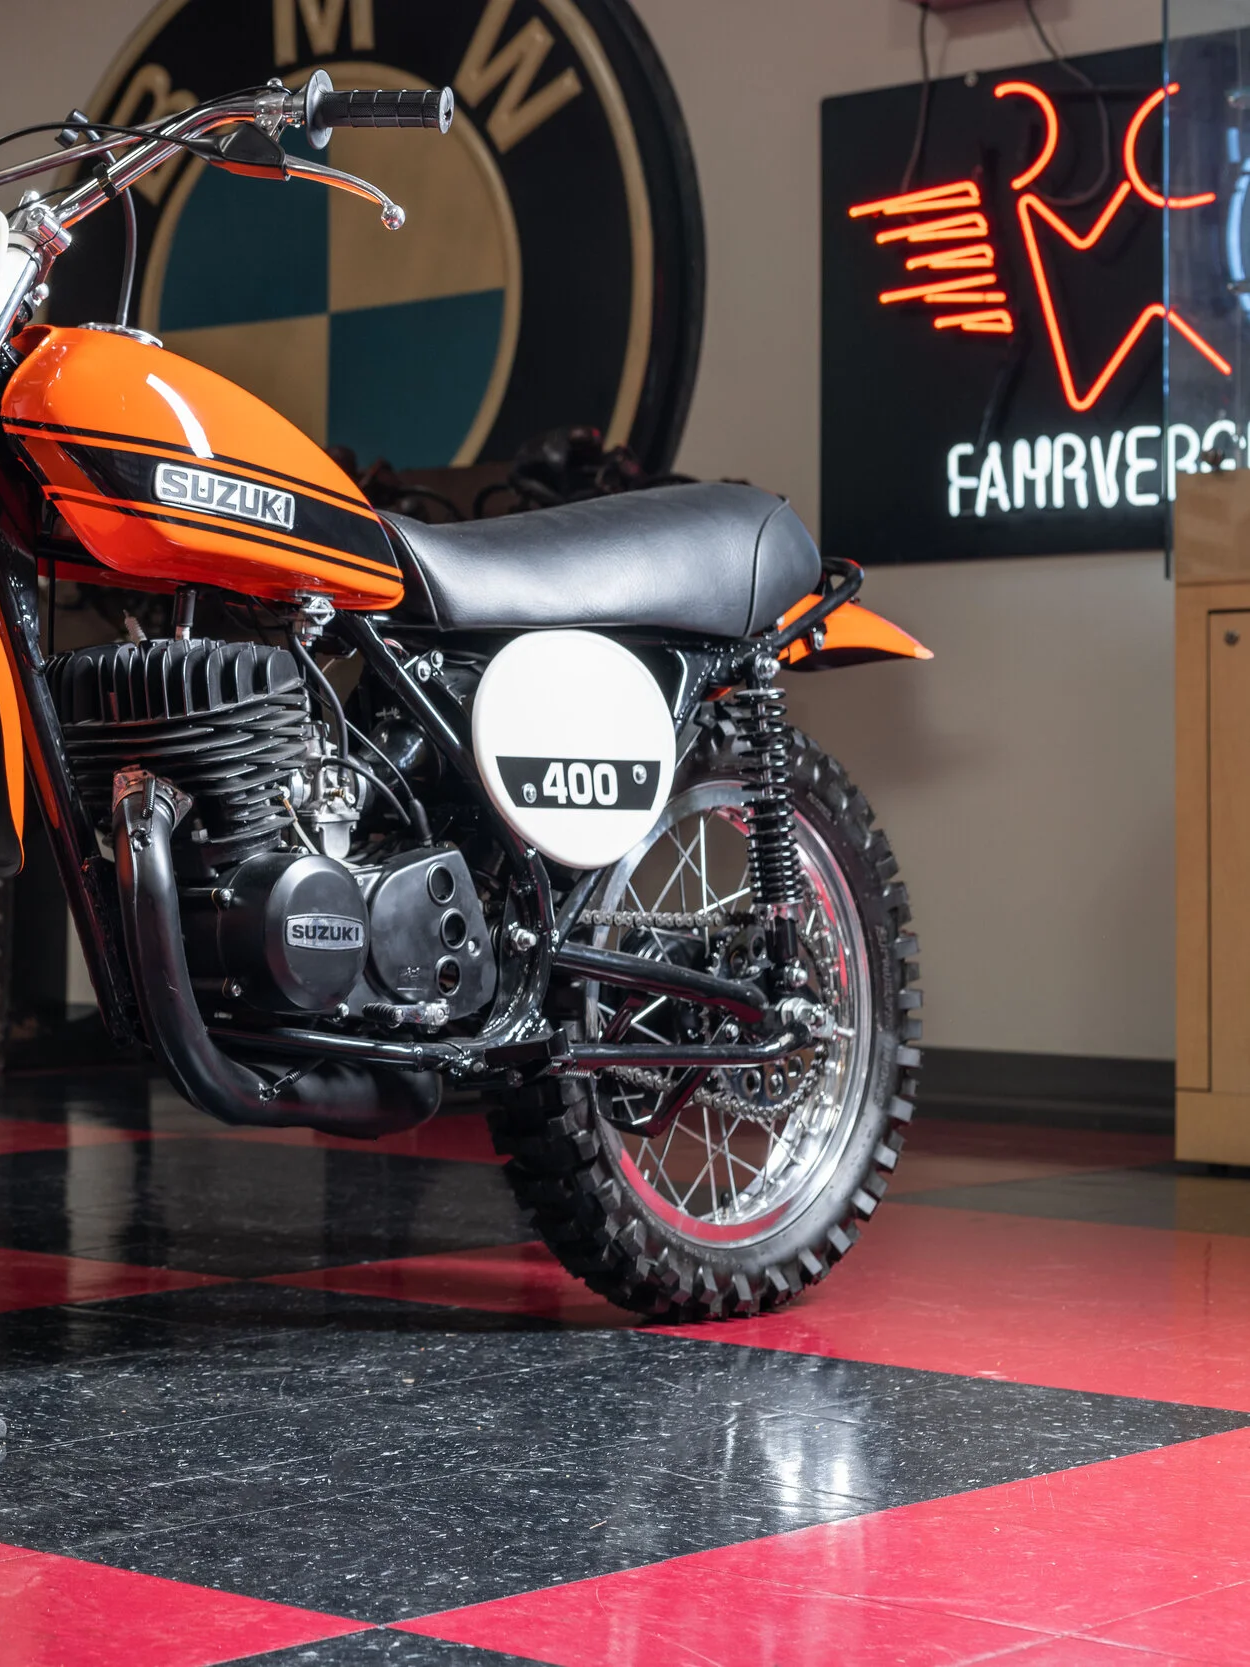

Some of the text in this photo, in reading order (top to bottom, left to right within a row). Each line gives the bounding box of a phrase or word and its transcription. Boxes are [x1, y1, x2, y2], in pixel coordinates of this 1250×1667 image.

[948, 419, 1250, 517] FAHRVERG
[161, 468, 293, 526] SUZUKI
[542, 761, 618, 806] 400
[291, 923, 360, 942] SUZUKI
